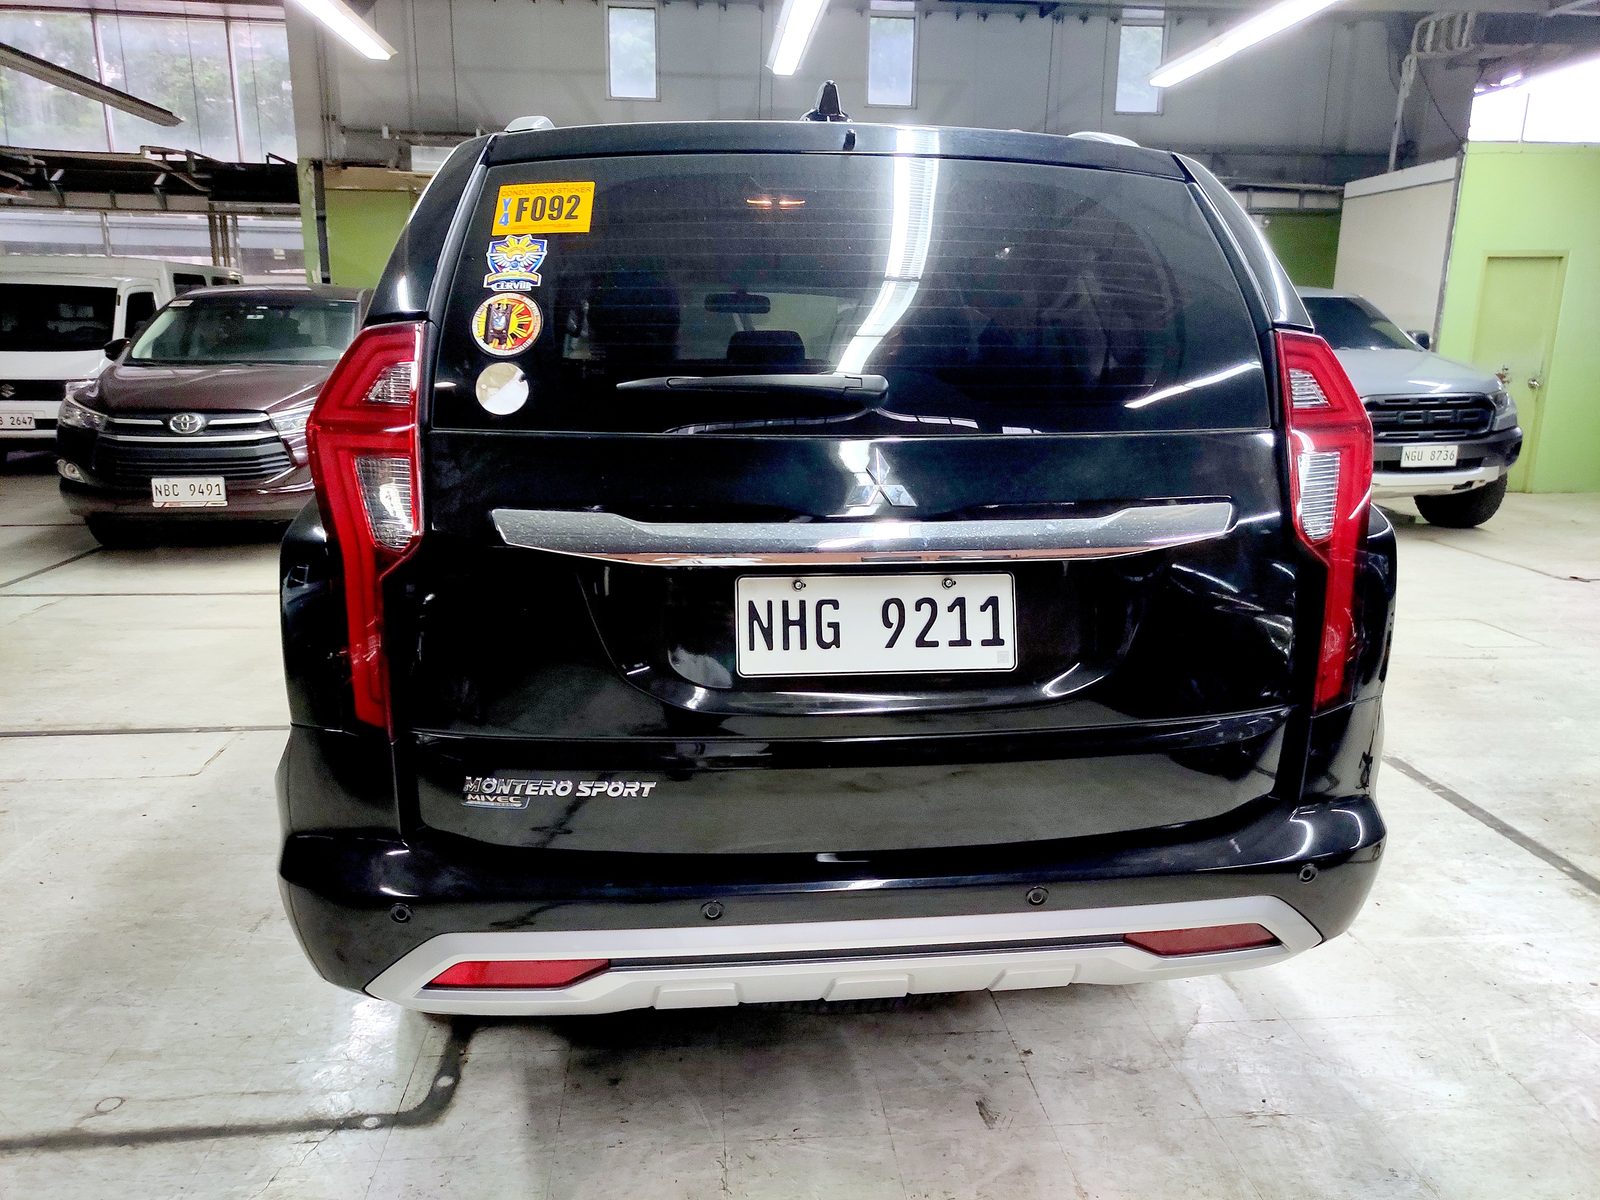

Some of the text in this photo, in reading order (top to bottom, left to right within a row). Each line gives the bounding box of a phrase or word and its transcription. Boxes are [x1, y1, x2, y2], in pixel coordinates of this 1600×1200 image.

[501, 188, 555, 197] CONDUCTION
[557, 186, 592, 194] STICKER
[515, 195, 580, 222] F092
[10, 416, 33, 426] 2647
[1404, 450, 1455, 462] NGU 8736
[155, 483, 222, 497] NBC 9491
[748, 595, 1005, 652] NHG 9211
[462, 776, 657, 798] MONTERO SPORT
[467, 794, 522, 803] MIVEC
